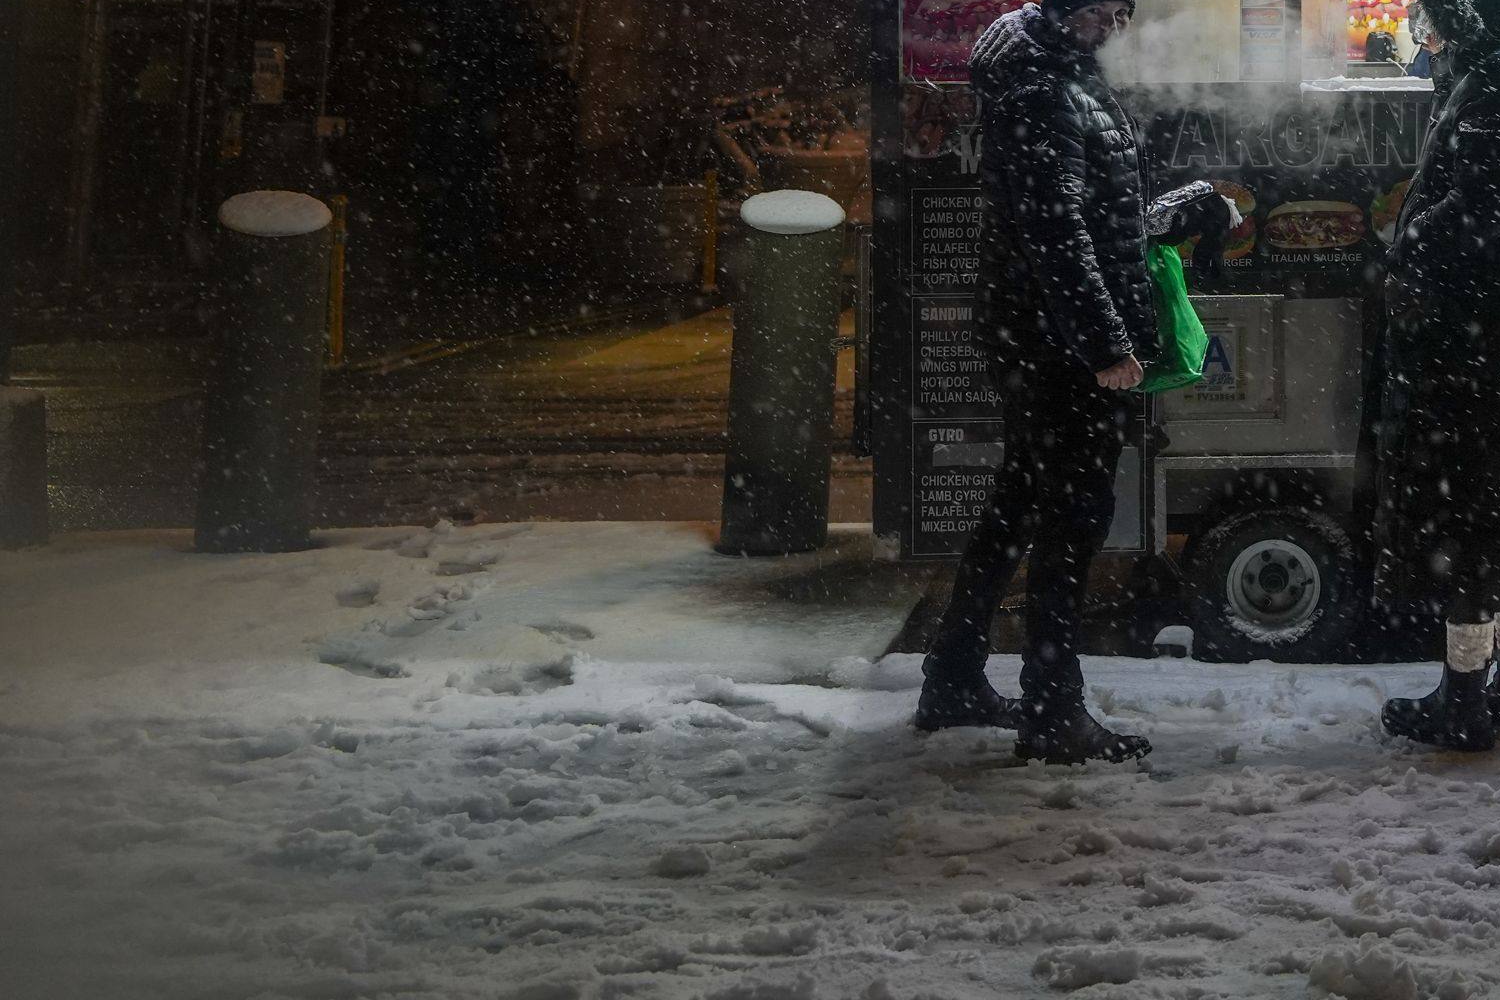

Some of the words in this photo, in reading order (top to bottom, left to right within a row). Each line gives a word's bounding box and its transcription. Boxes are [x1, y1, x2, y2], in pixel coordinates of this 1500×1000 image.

[1171, 100, 1432, 168] ARGAN
[922, 197, 971, 208] CHICKEN
[922, 212, 953, 224] LAMB
[922, 227, 963, 239] COMBO
[966, 227, 982, 239] OV
[922, 243, 971, 254] FALAFEL
[922, 258, 947, 269] FISH
[950, 258, 980, 269] OVER
[1271, 254, 1310, 263] ITALIAN
[1313, 252, 1363, 263] SAUSAGE
[922, 274, 960, 285] KOFTA
[962, 274, 978, 285] OV
[920, 307, 973, 321] SANDWI
[921, 331, 959, 342] PHILLY
[921, 345, 987, 358] CHEESEBU
[1202, 335, 1232, 372] A
[921, 361, 957, 373] WINGS
[959, 361, 987, 372] WITH
[921, 377, 944, 388] HOT
[946, 377, 970, 388] DOG
[921, 391, 963, 403] ITALIAN
[965, 391, 1003, 403] SAUSA
[928, 428, 965, 442] GYRO
[921, 475, 969, 487] CHICKEN
[972, 474, 996, 486] GYR
[921, 490, 952, 502] LAMB
[955, 490, 986, 501] GYRO
[921, 505, 970, 517] FALAFEL
[921, 520, 956, 532] MIXED
